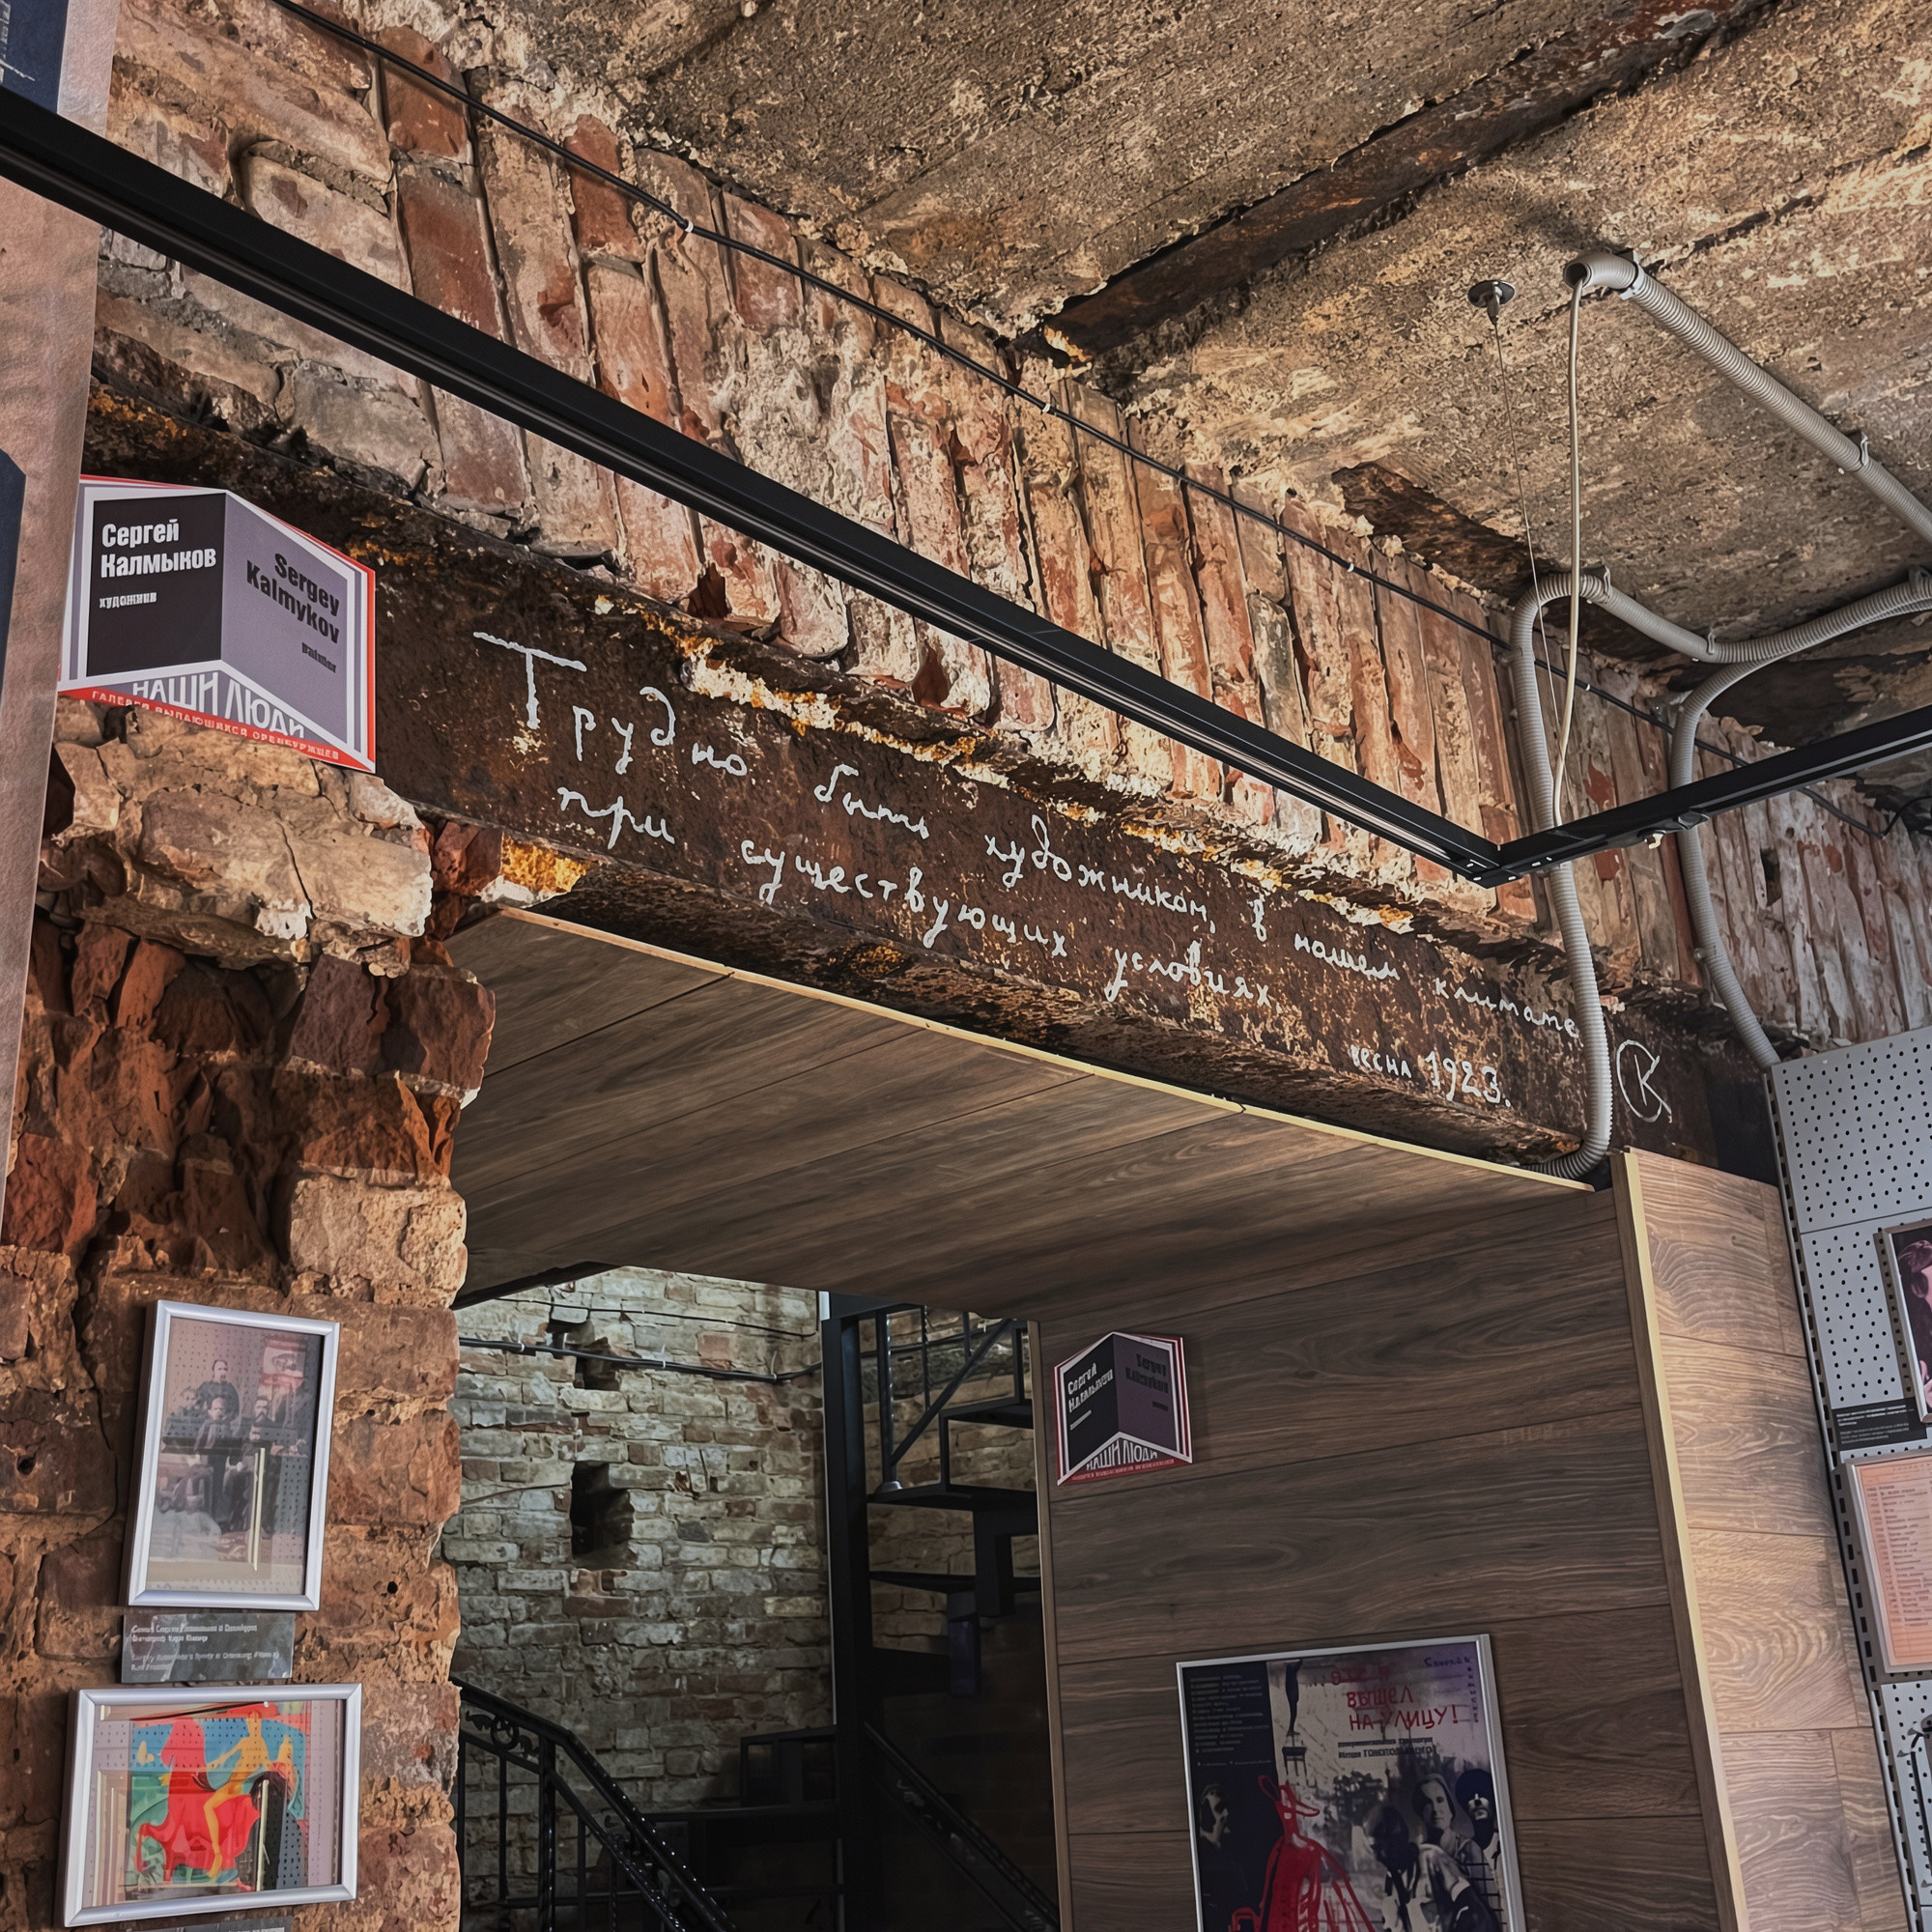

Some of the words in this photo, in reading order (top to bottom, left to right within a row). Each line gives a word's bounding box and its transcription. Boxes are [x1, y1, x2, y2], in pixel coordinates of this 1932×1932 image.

[101, 518, 180, 549] Сергей
[100, 548, 217, 579] Калмыков
[99, 592, 157, 610] художник
[246, 559, 340, 644] Kalmykov
[274, 553, 340, 617] Sergey
[301, 641, 337, 674] painter
[132, 671, 219, 718] НАШИ
[224, 679, 305, 739] ЛЮДИ
[472, 631, 748, 776] Трудно
[814, 763, 930, 839] быть
[1293, 932, 1401, 980] нашем
[1434, 976, 1581, 1039] климате
[556, 786, 675, 850] при
[740, 839, 1068, 958] существующих
[1103, 939, 1272, 1003] условиях
[1086, 1440, 1121, 1471] НАШИ
[1122, 1439, 1158, 1464] ЛЮДИ
[1349, 1714, 1374, 1731] НА
[1379, 1704, 1459, 1732] УЛИЦУ!
